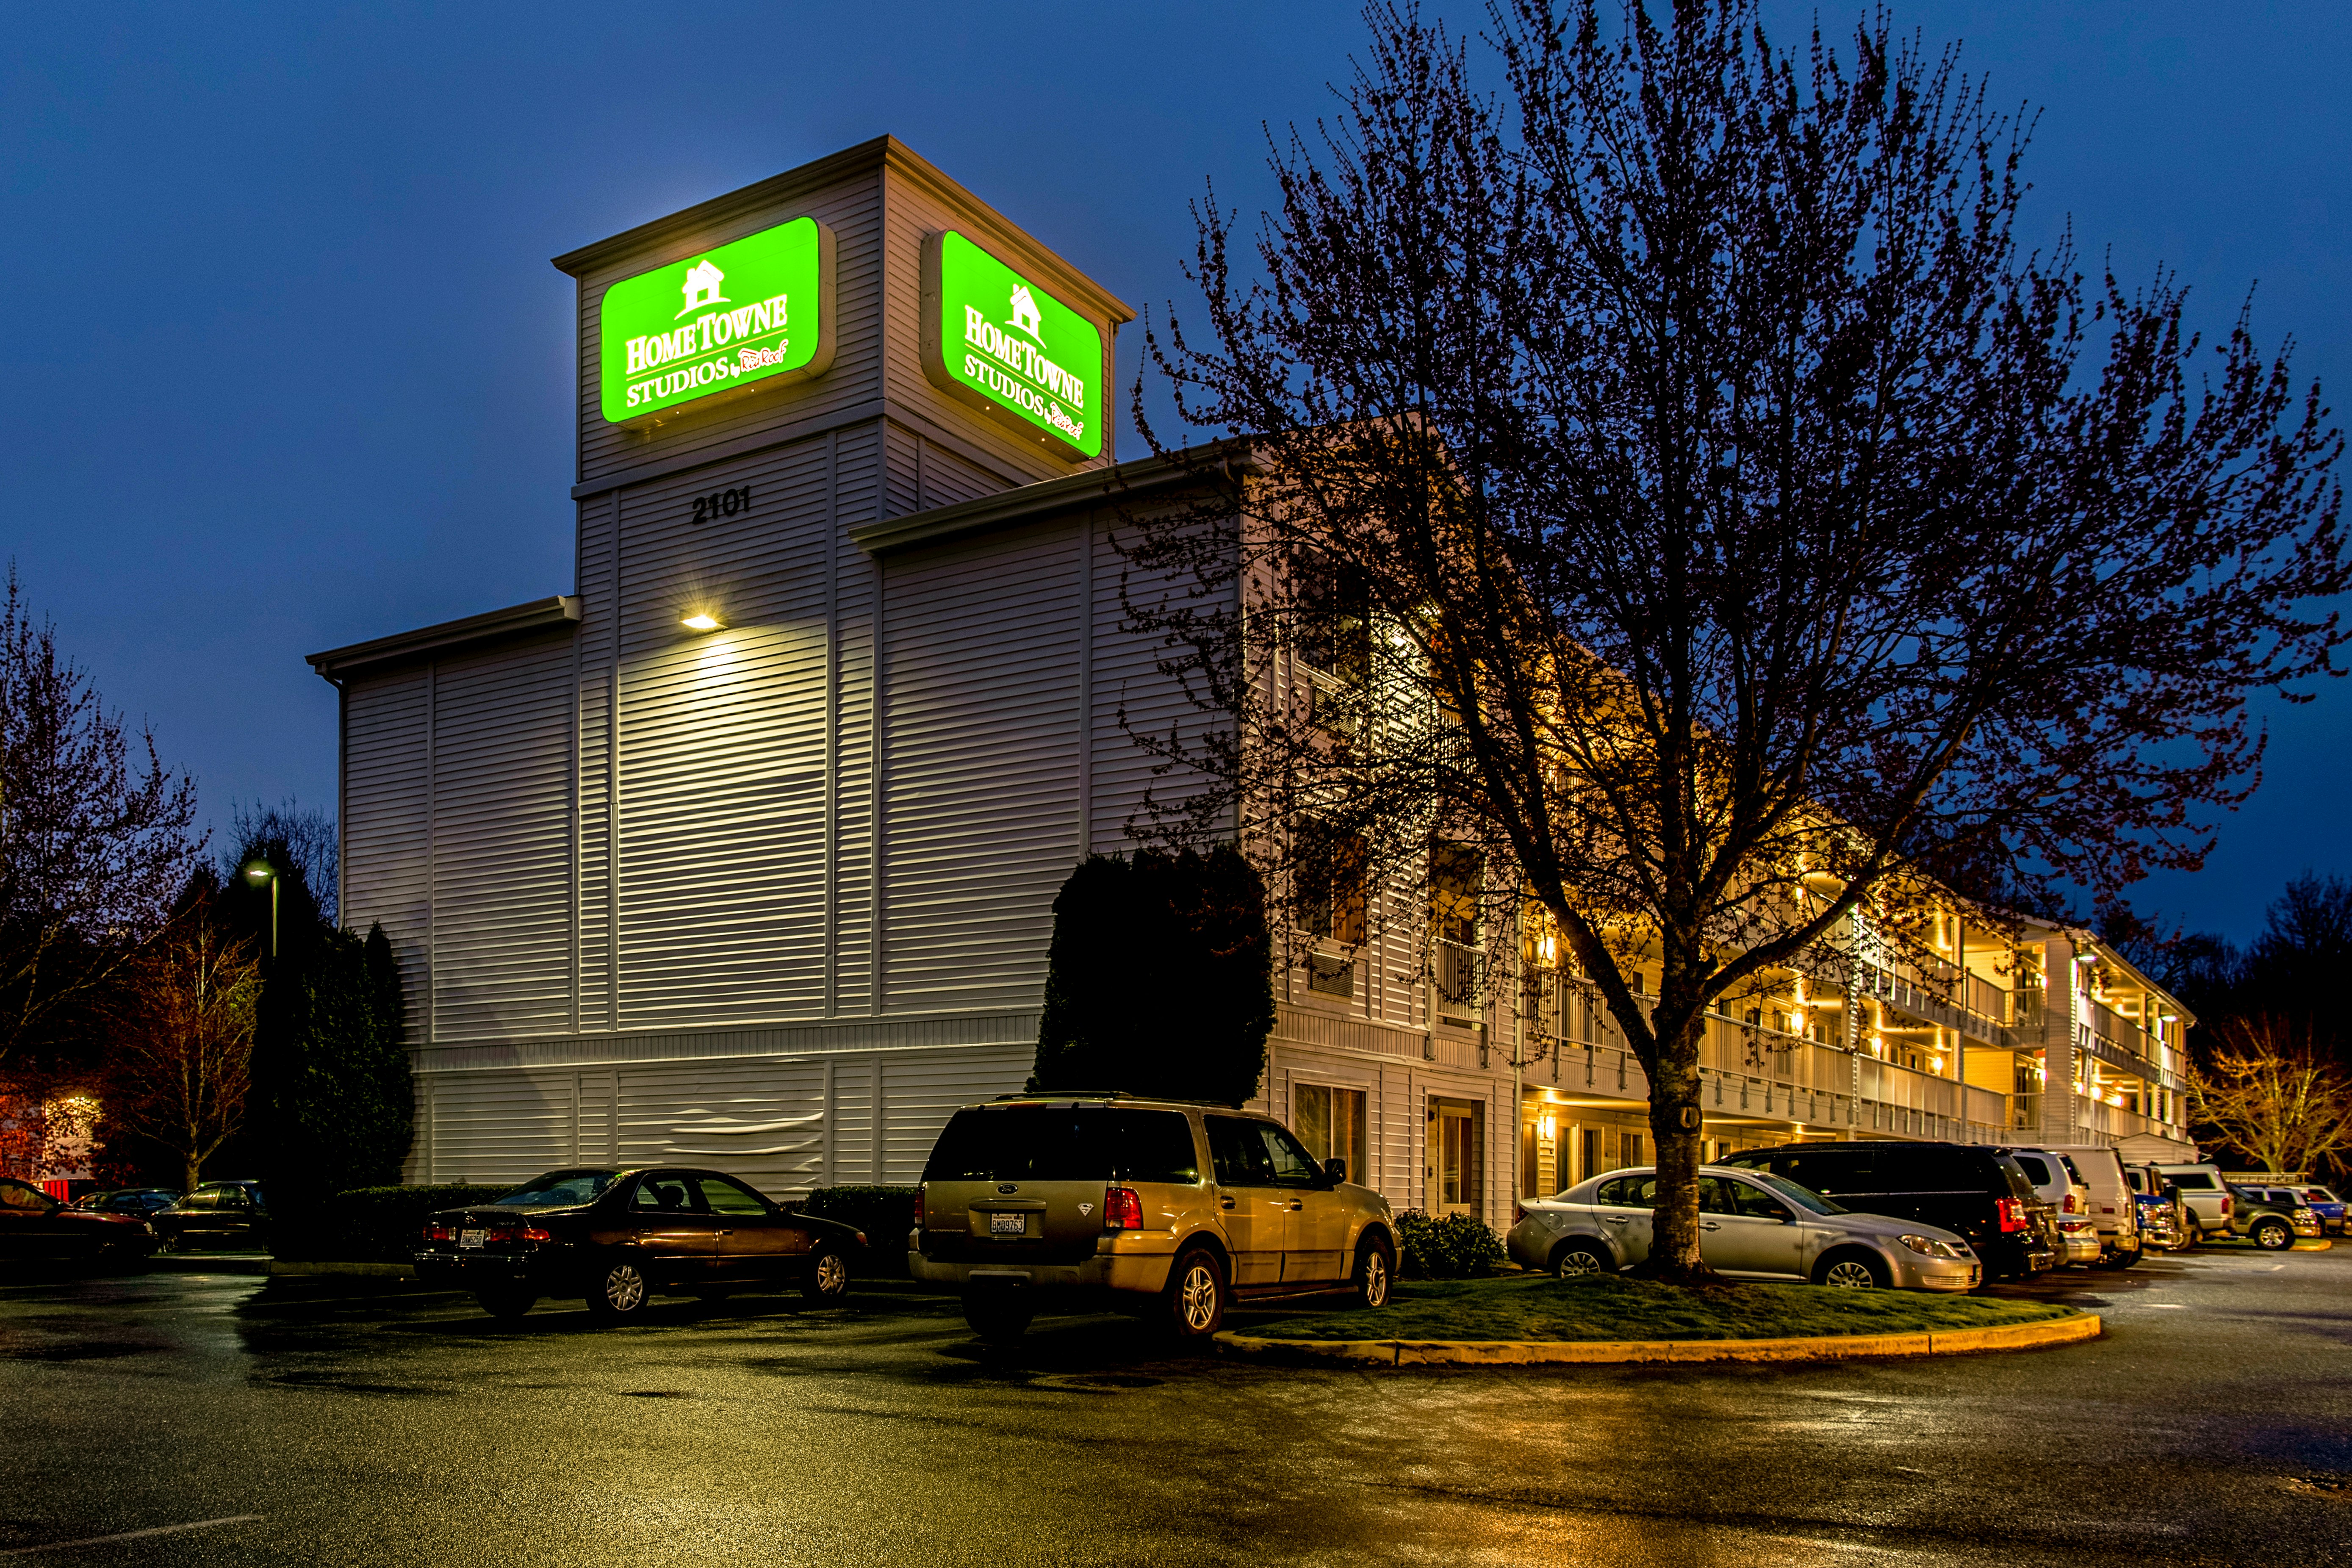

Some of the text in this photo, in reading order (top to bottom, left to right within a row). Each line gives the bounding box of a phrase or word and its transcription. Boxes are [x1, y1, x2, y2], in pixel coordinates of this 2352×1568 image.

[627, 357, 729, 407] STUDIOS
[964, 355, 1044, 416] STUDIOS
[692, 485, 750, 524] 2101
